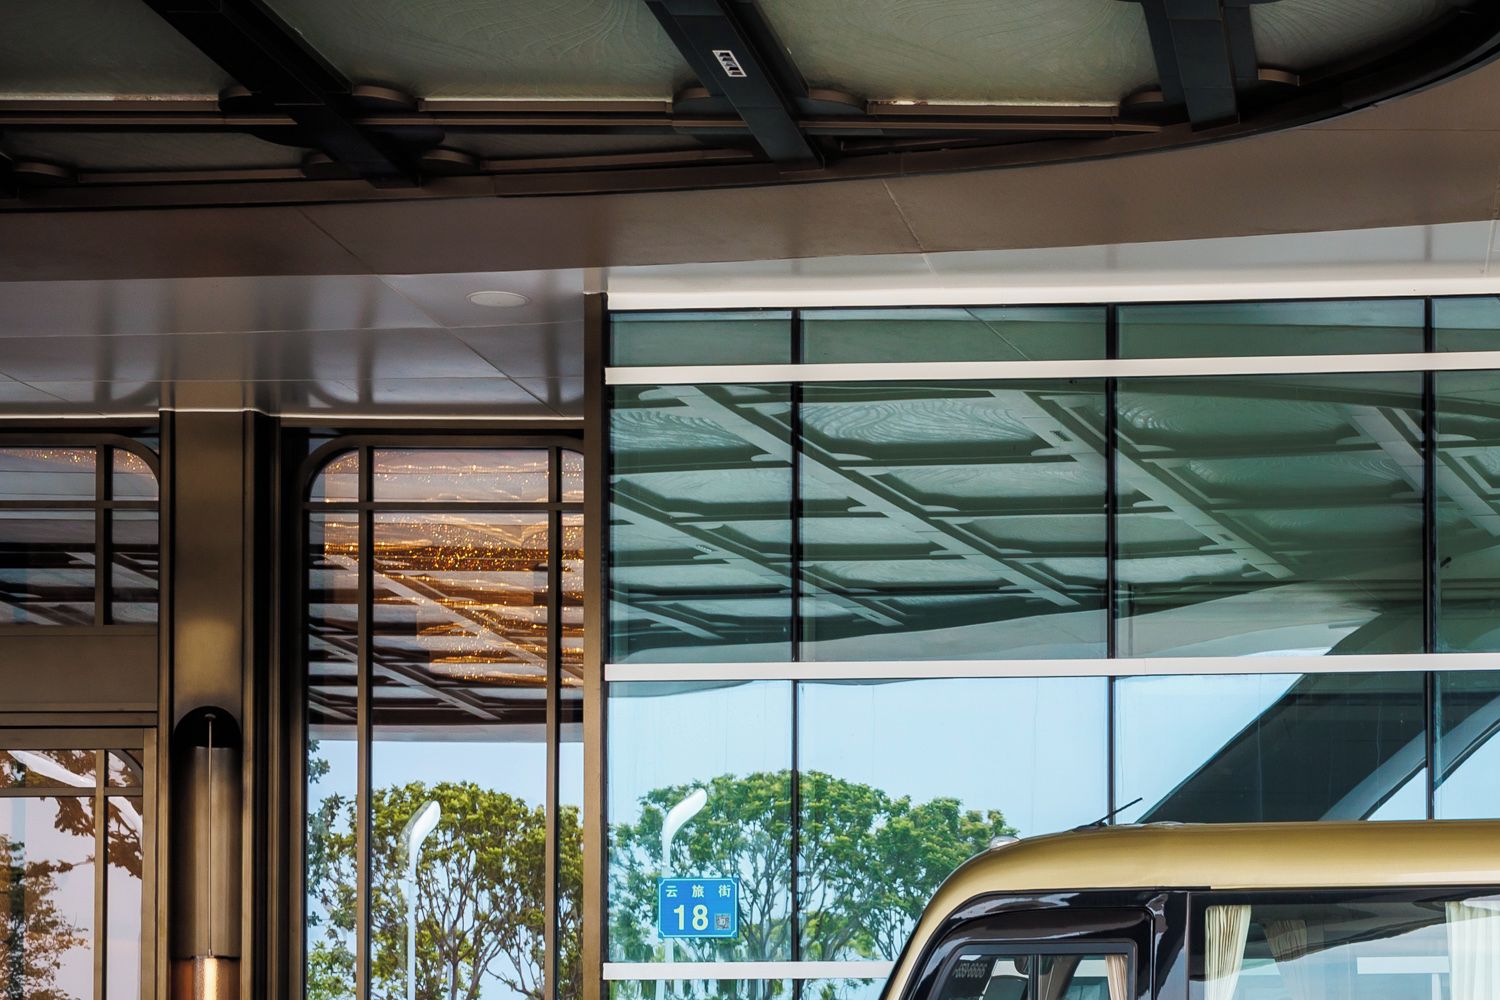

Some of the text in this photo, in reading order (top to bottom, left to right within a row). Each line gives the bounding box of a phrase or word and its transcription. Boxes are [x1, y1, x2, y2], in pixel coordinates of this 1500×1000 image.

[665, 884, 731, 899] 云旅街
[673, 904, 709, 931] 18
